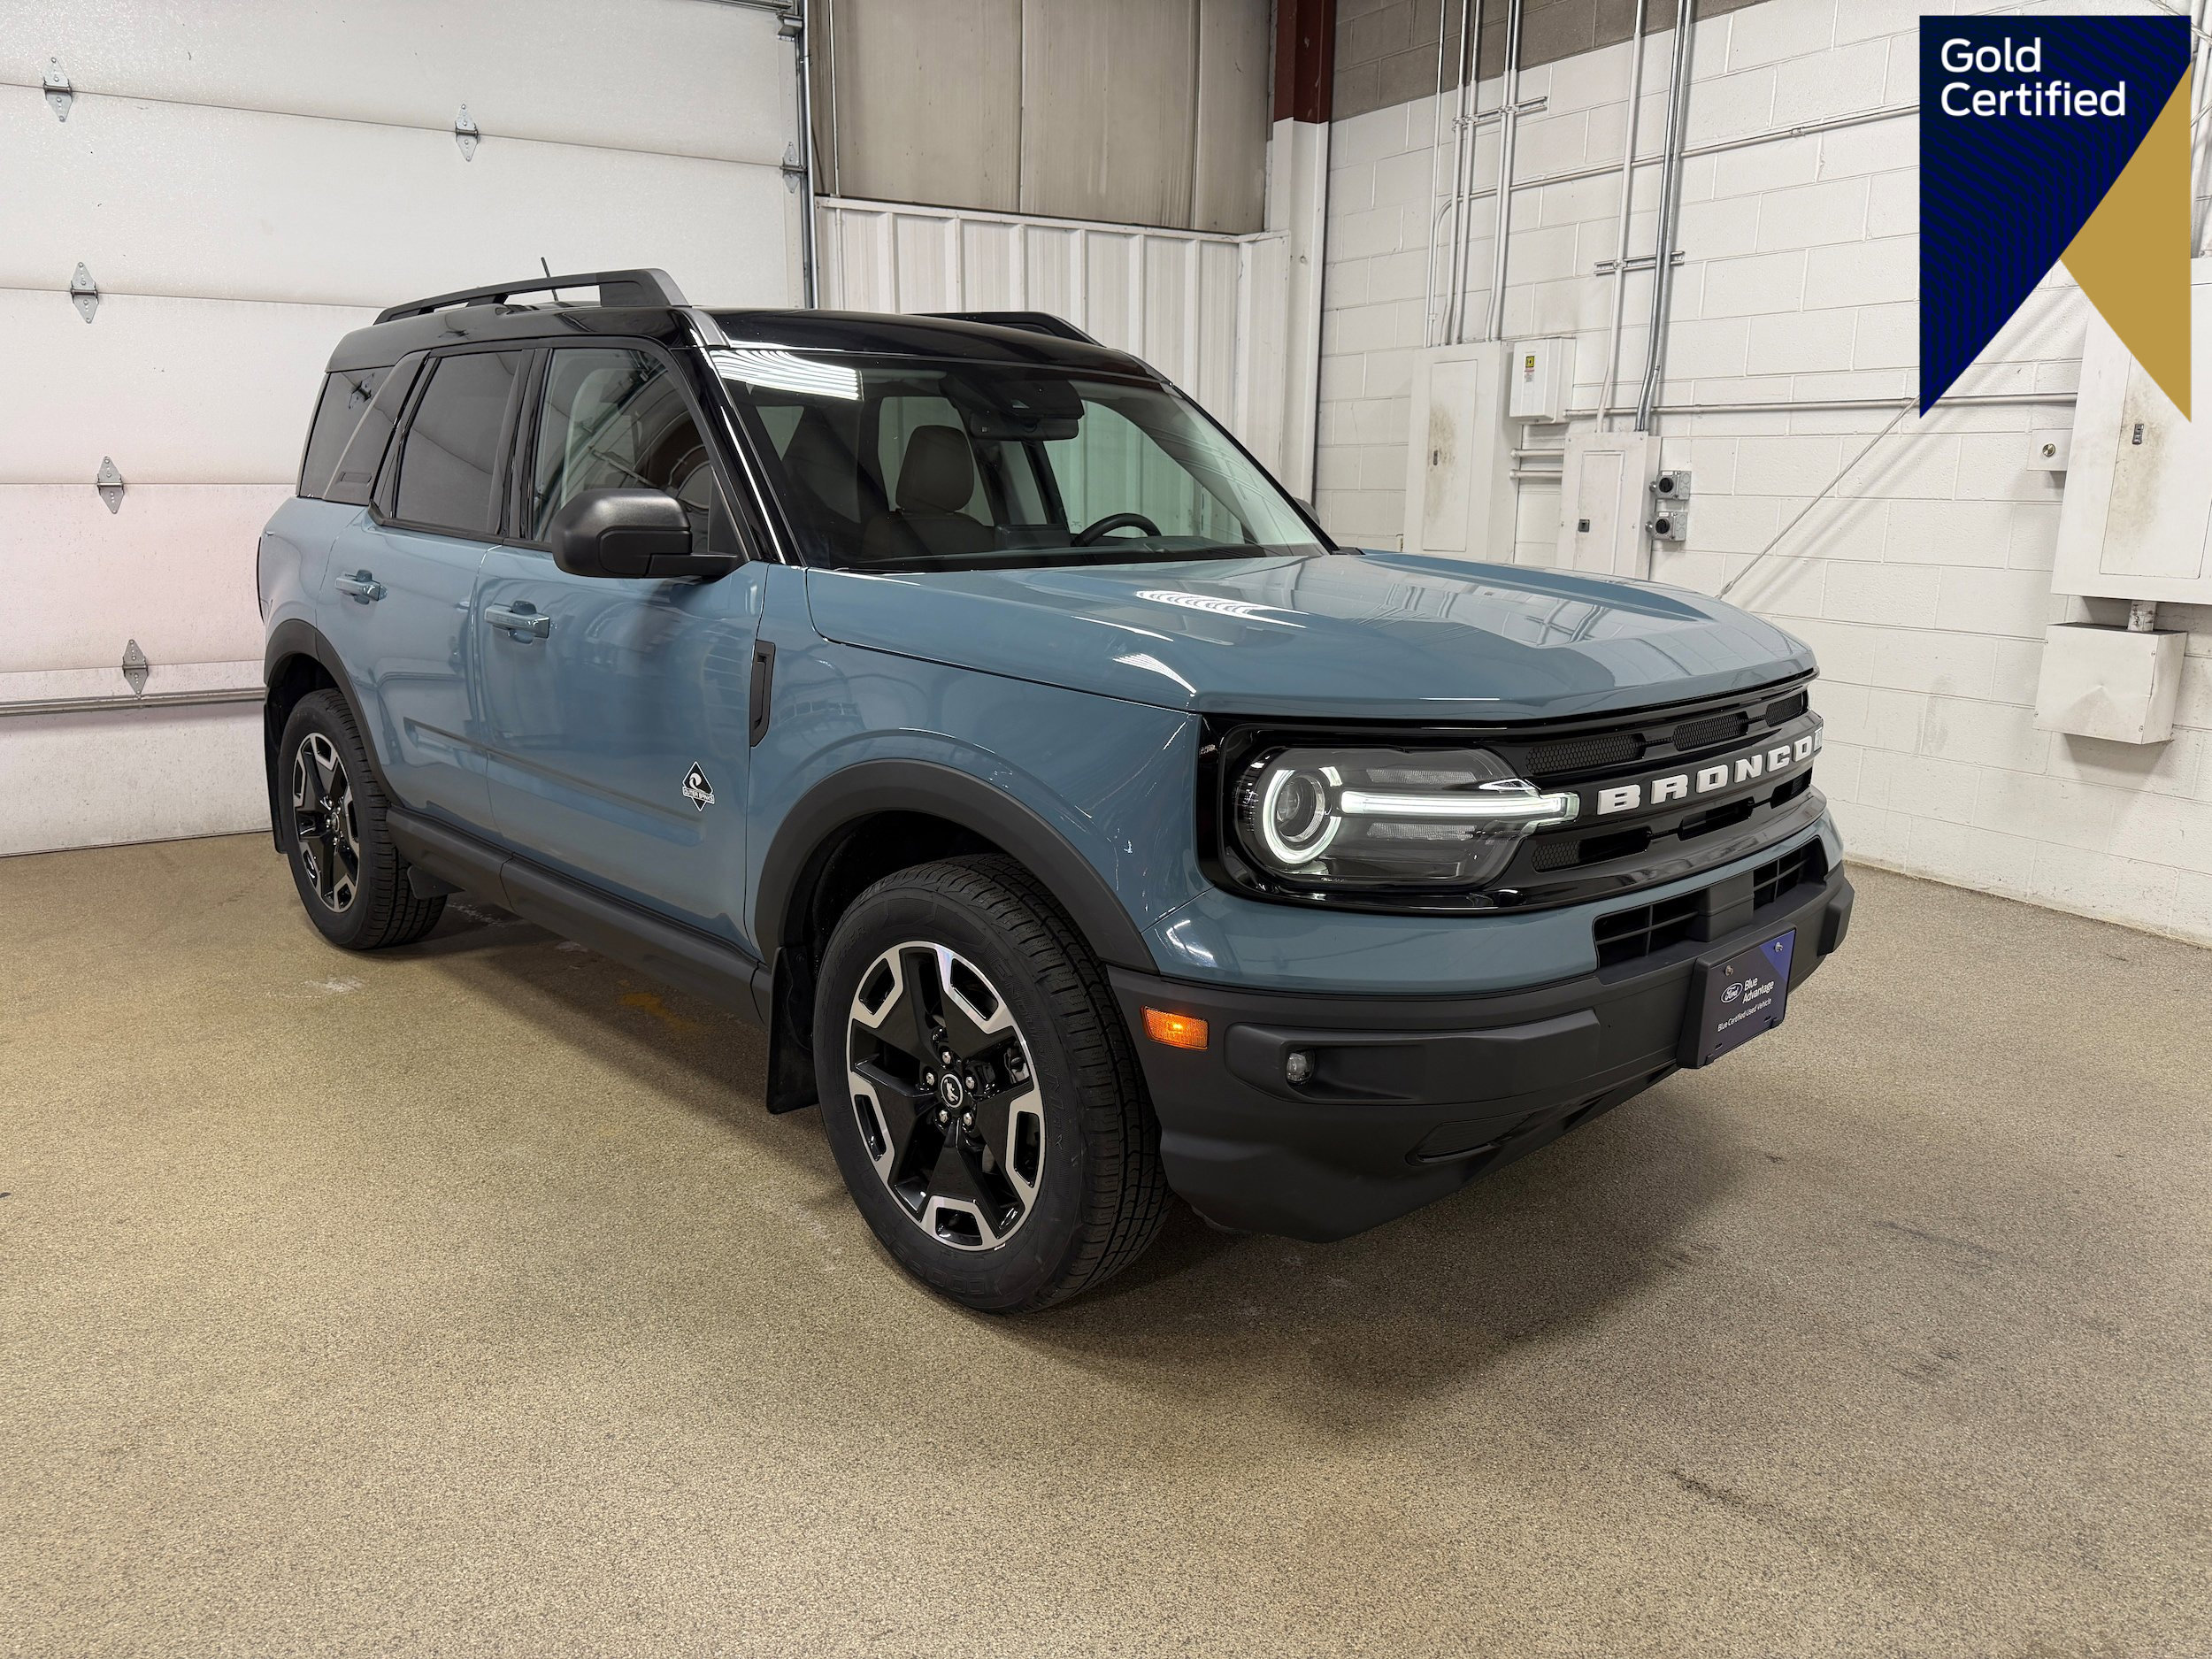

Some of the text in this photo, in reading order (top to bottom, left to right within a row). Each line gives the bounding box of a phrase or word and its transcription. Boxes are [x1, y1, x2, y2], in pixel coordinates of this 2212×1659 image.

[1596, 734, 1812, 816] BRONCO
[1742, 980, 1774, 1003] Advantage
[1744, 977, 1758, 990] Blue
[1717, 1022, 1728, 1032] Blue
